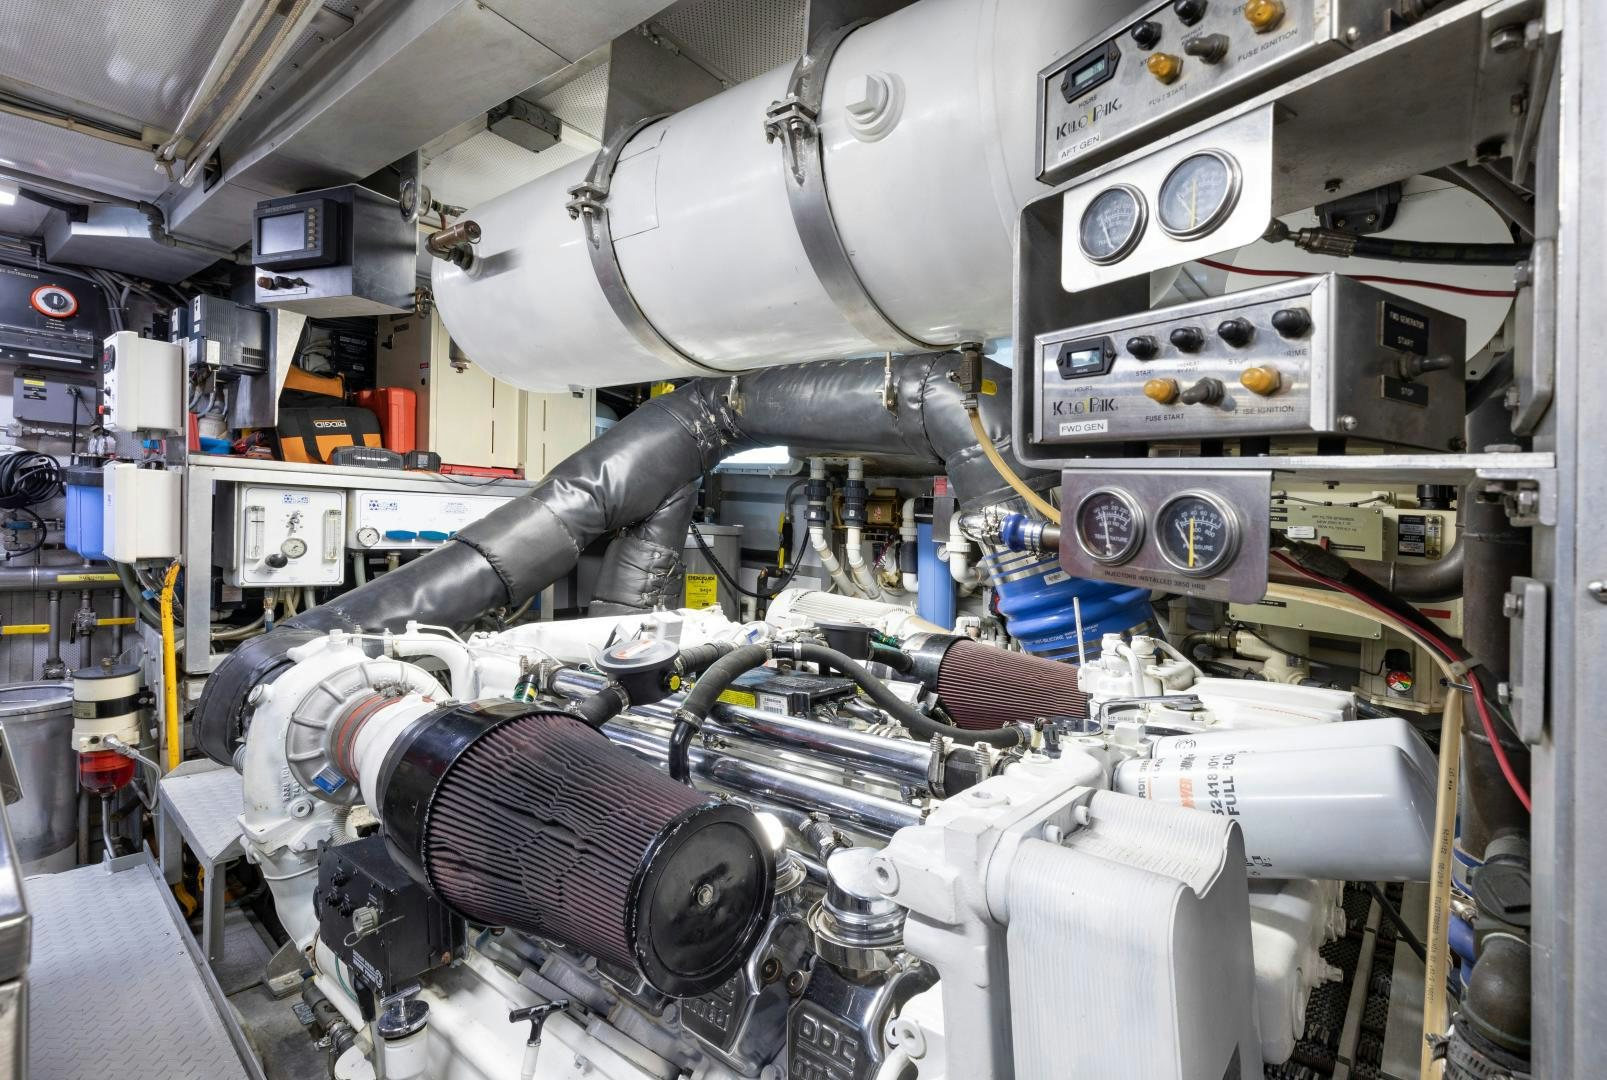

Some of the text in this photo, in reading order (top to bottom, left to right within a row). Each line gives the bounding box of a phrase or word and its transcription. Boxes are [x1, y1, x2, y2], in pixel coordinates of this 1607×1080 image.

[1260, 28, 1299, 54] IGNITION
[1060, 134, 1100, 160] AFT GEN
[1397, 336, 1414, 348] START
[1400, 387, 1414, 397] STOP
[1256, 405, 1295, 415] IGNITION
[1145, 413, 1185, 424] FUSE START
[1061, 422, 1105, 434] FWD GEN
[1104, 569, 1137, 582] INJECTORS
[1138, 574, 1173, 586] INSTALLED
[1222, 775, 1240, 816] FULL
[798, 1014, 858, 1068] DDC
